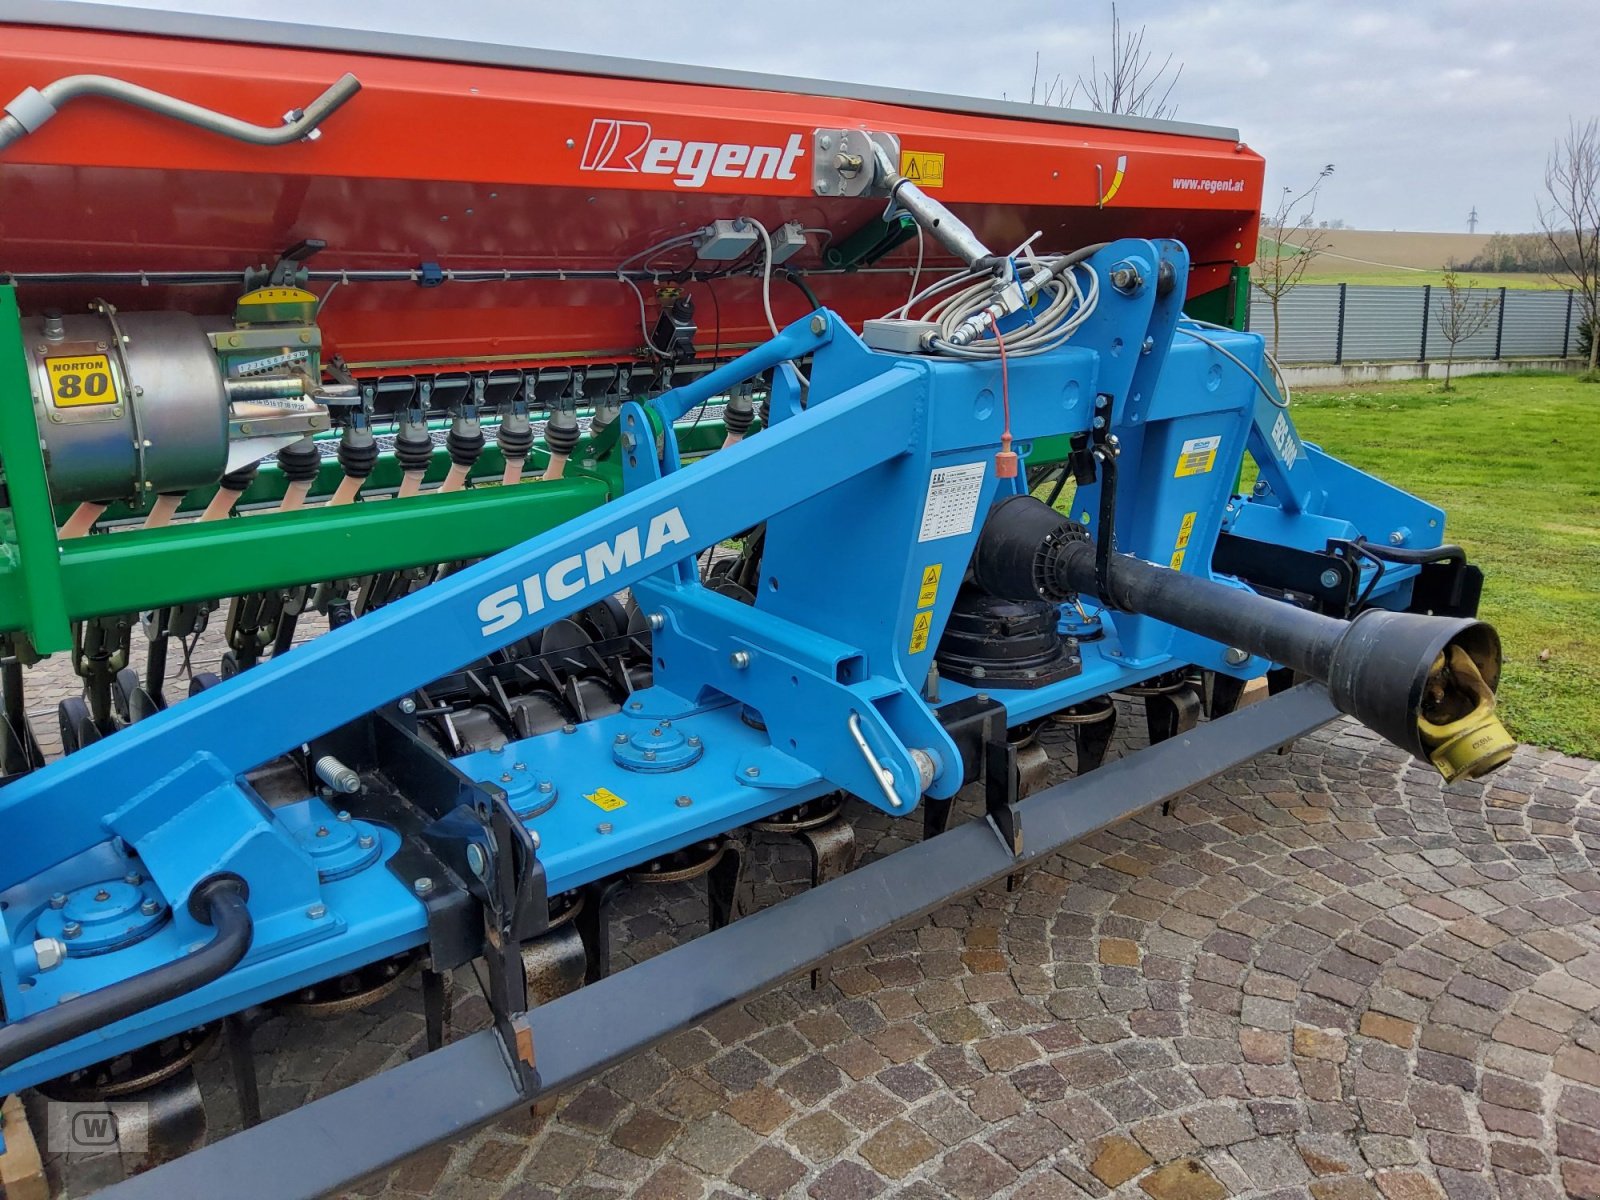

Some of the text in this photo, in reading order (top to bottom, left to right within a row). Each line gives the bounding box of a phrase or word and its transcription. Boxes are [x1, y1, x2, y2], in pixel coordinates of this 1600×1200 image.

[579, 118, 805, 188] Regent
[1172, 178, 1244, 194] www.regent.at
[53, 361, 104, 372] NORTON
[58, 372, 108, 398] 80
[477, 507, 691, 637] SICMA
